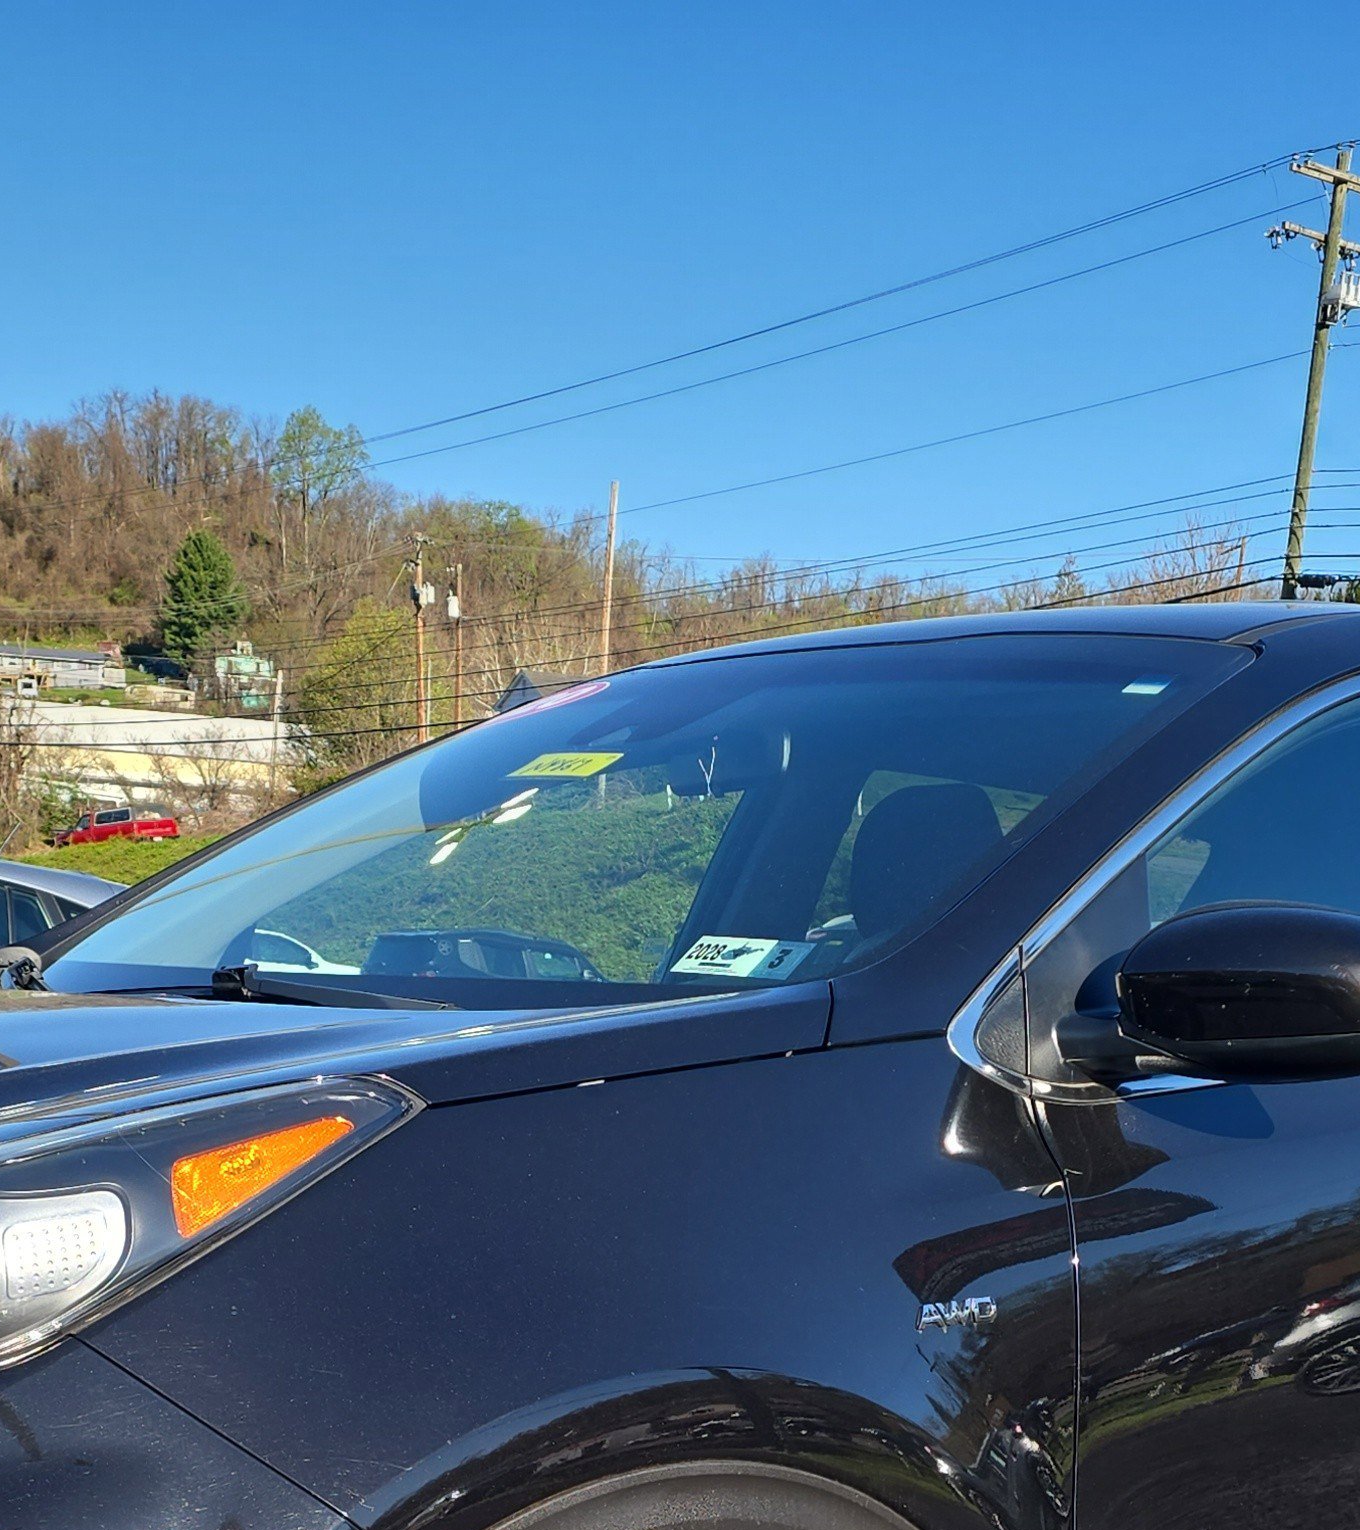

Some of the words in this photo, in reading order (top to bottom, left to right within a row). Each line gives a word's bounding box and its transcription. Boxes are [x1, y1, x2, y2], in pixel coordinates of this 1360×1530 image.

[686, 942, 727, 961] 2028
[768, 948, 793, 969] 3
[915, 1296, 998, 1334] AWD
